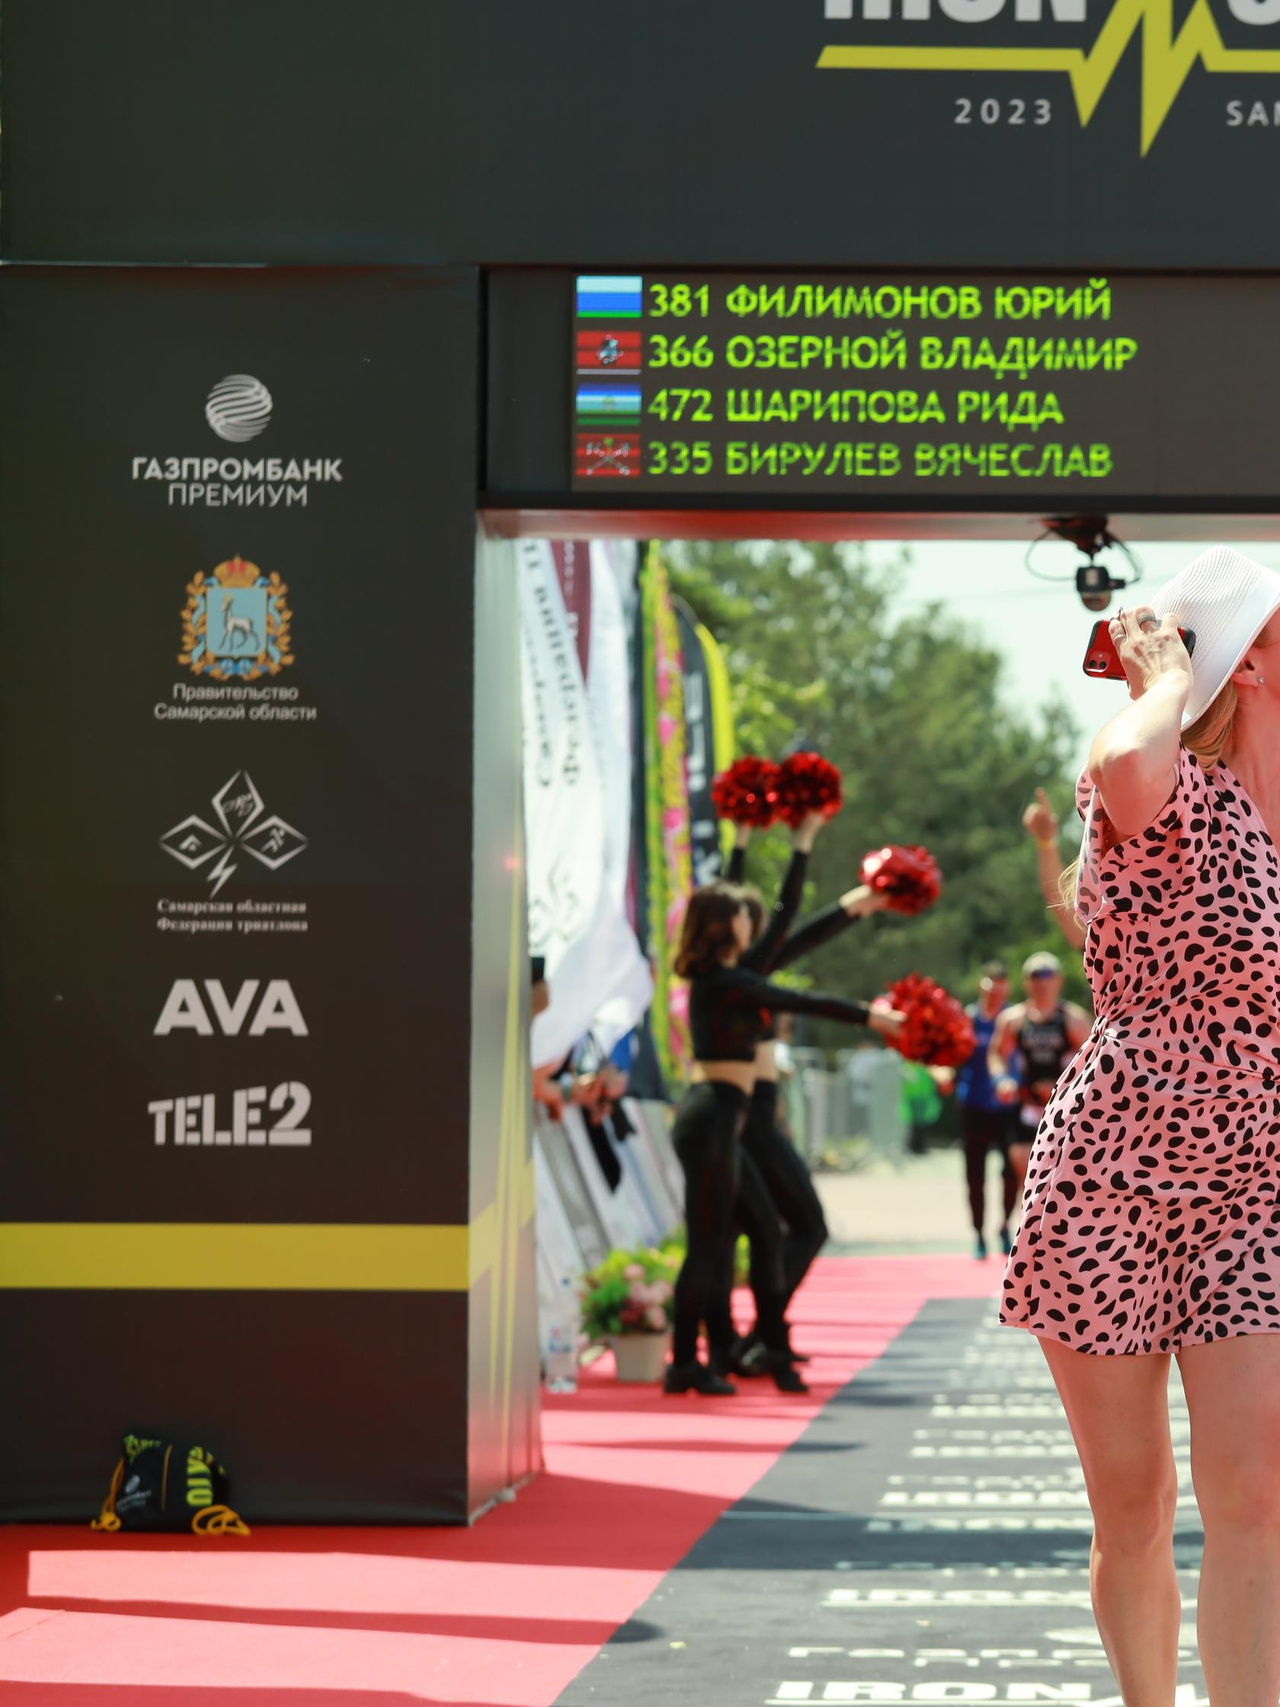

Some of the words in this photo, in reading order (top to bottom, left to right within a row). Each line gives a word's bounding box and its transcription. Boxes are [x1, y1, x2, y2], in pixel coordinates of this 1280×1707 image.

[954, 98, 1052, 126] 2023
[648, 283, 710, 318] 381
[726, 283, 981, 319] ФИЛИМОНОВ
[995, 277, 1111, 319] ЮРИЙ
[648, 335, 714, 369] 366
[726, 328, 906, 370] ОЗЕРНОЙ
[920, 337, 1138, 380] ВЛАДИМИР
[648, 389, 713, 422] 472
[726, 389, 946, 424] ШАРИПОВА
[957, 390, 1065, 432] РИДА
[132, 456, 343, 481] ГАЗПРОМБАНК
[648, 442, 712, 476] 335
[726, 441, 901, 477] БИРУЛЕВ
[914, 442, 1114, 477] ВЯЧЕСЛАВ
[168, 482, 308, 507] ПРЕМИУМ
[173, 683, 299, 702] Правительство
[154, 703, 245, 722] Самарской
[249, 703, 317, 720] области
[157, 899, 233, 916] Самарская
[237, 898, 307, 914] областная
[157, 917, 233, 934] Федерация
[237, 919, 308, 934] триатлона
[153, 978, 309, 1037] AVA
[148, 1081, 312, 1147] TELE2
[776, 1681, 1091, 1700] IRON
